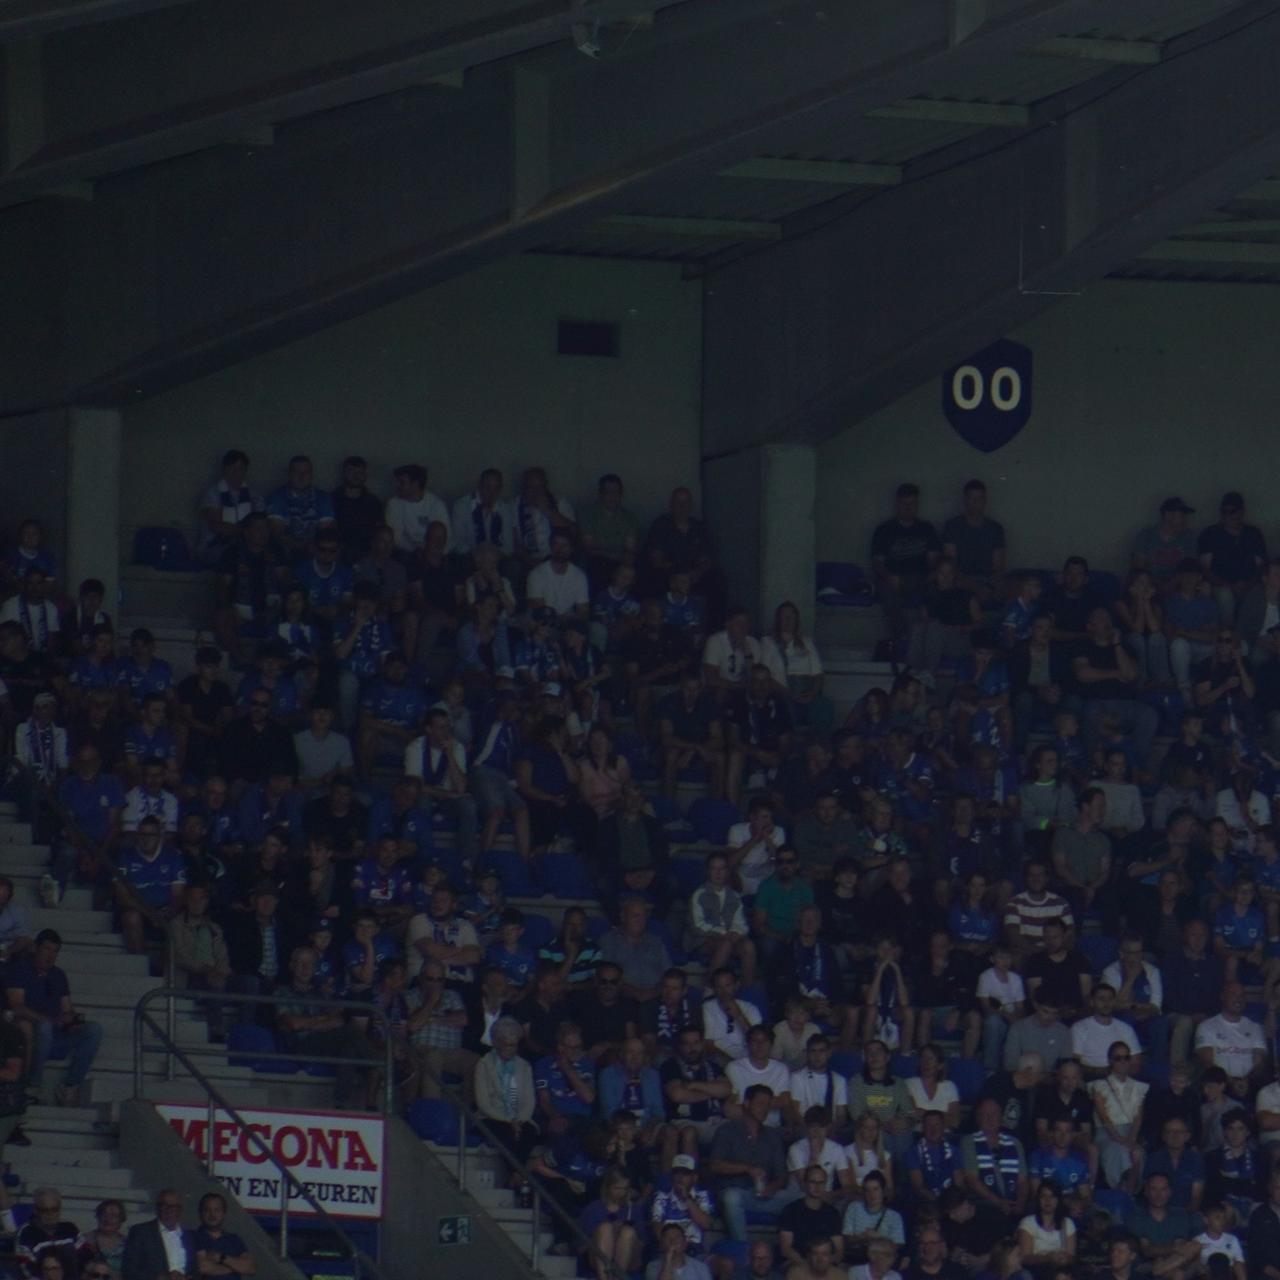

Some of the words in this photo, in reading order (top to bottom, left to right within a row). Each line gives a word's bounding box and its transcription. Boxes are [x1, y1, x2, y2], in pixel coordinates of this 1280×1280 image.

[170, 1118, 377, 1171] MECONA
[247, 1178, 279, 1198] EN
[287, 1179, 378, 1204] DEUREN
